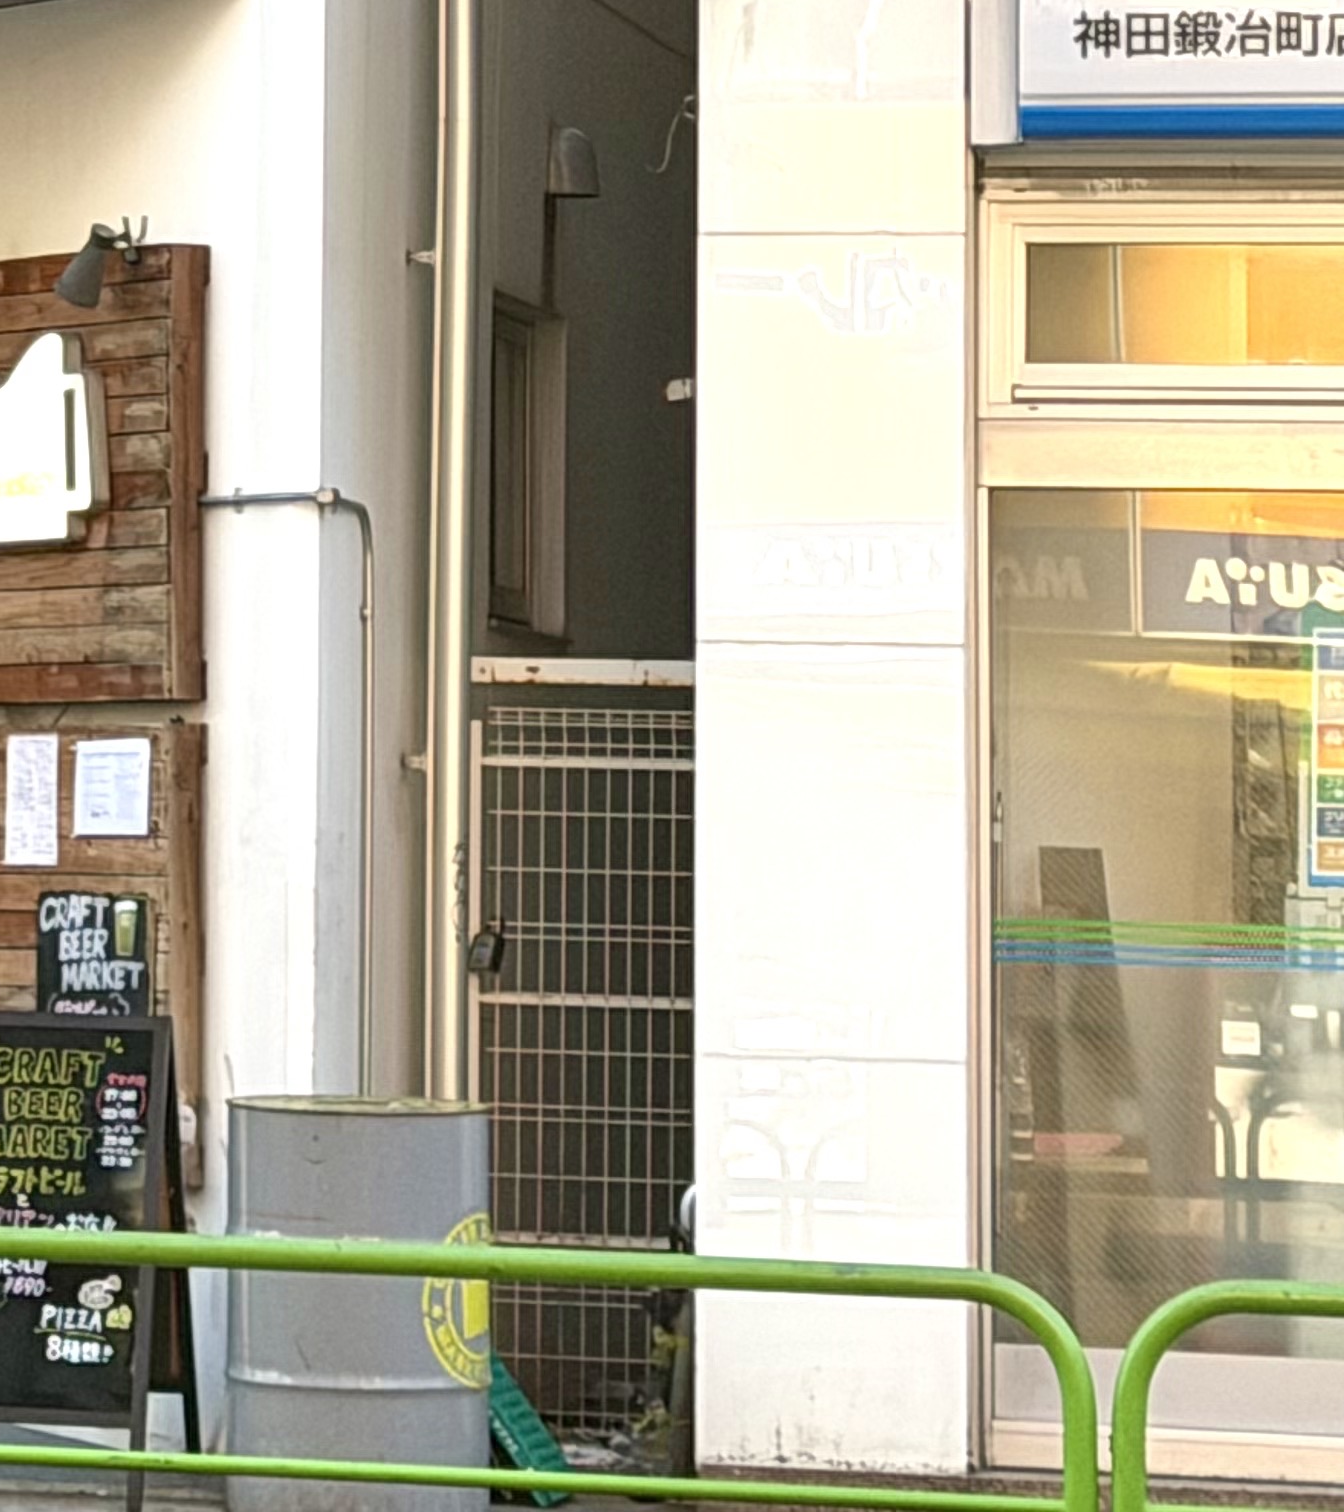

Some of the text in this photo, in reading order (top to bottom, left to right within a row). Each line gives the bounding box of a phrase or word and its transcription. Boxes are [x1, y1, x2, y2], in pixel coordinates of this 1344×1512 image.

[40, 894, 110, 933] CRAFT
[58, 928, 109, 961] BEER
[61, 959, 145, 993] MARKET
[3, 1086, 84, 1123] BEER
[40, 1304, 102, 1333] PIZZA
